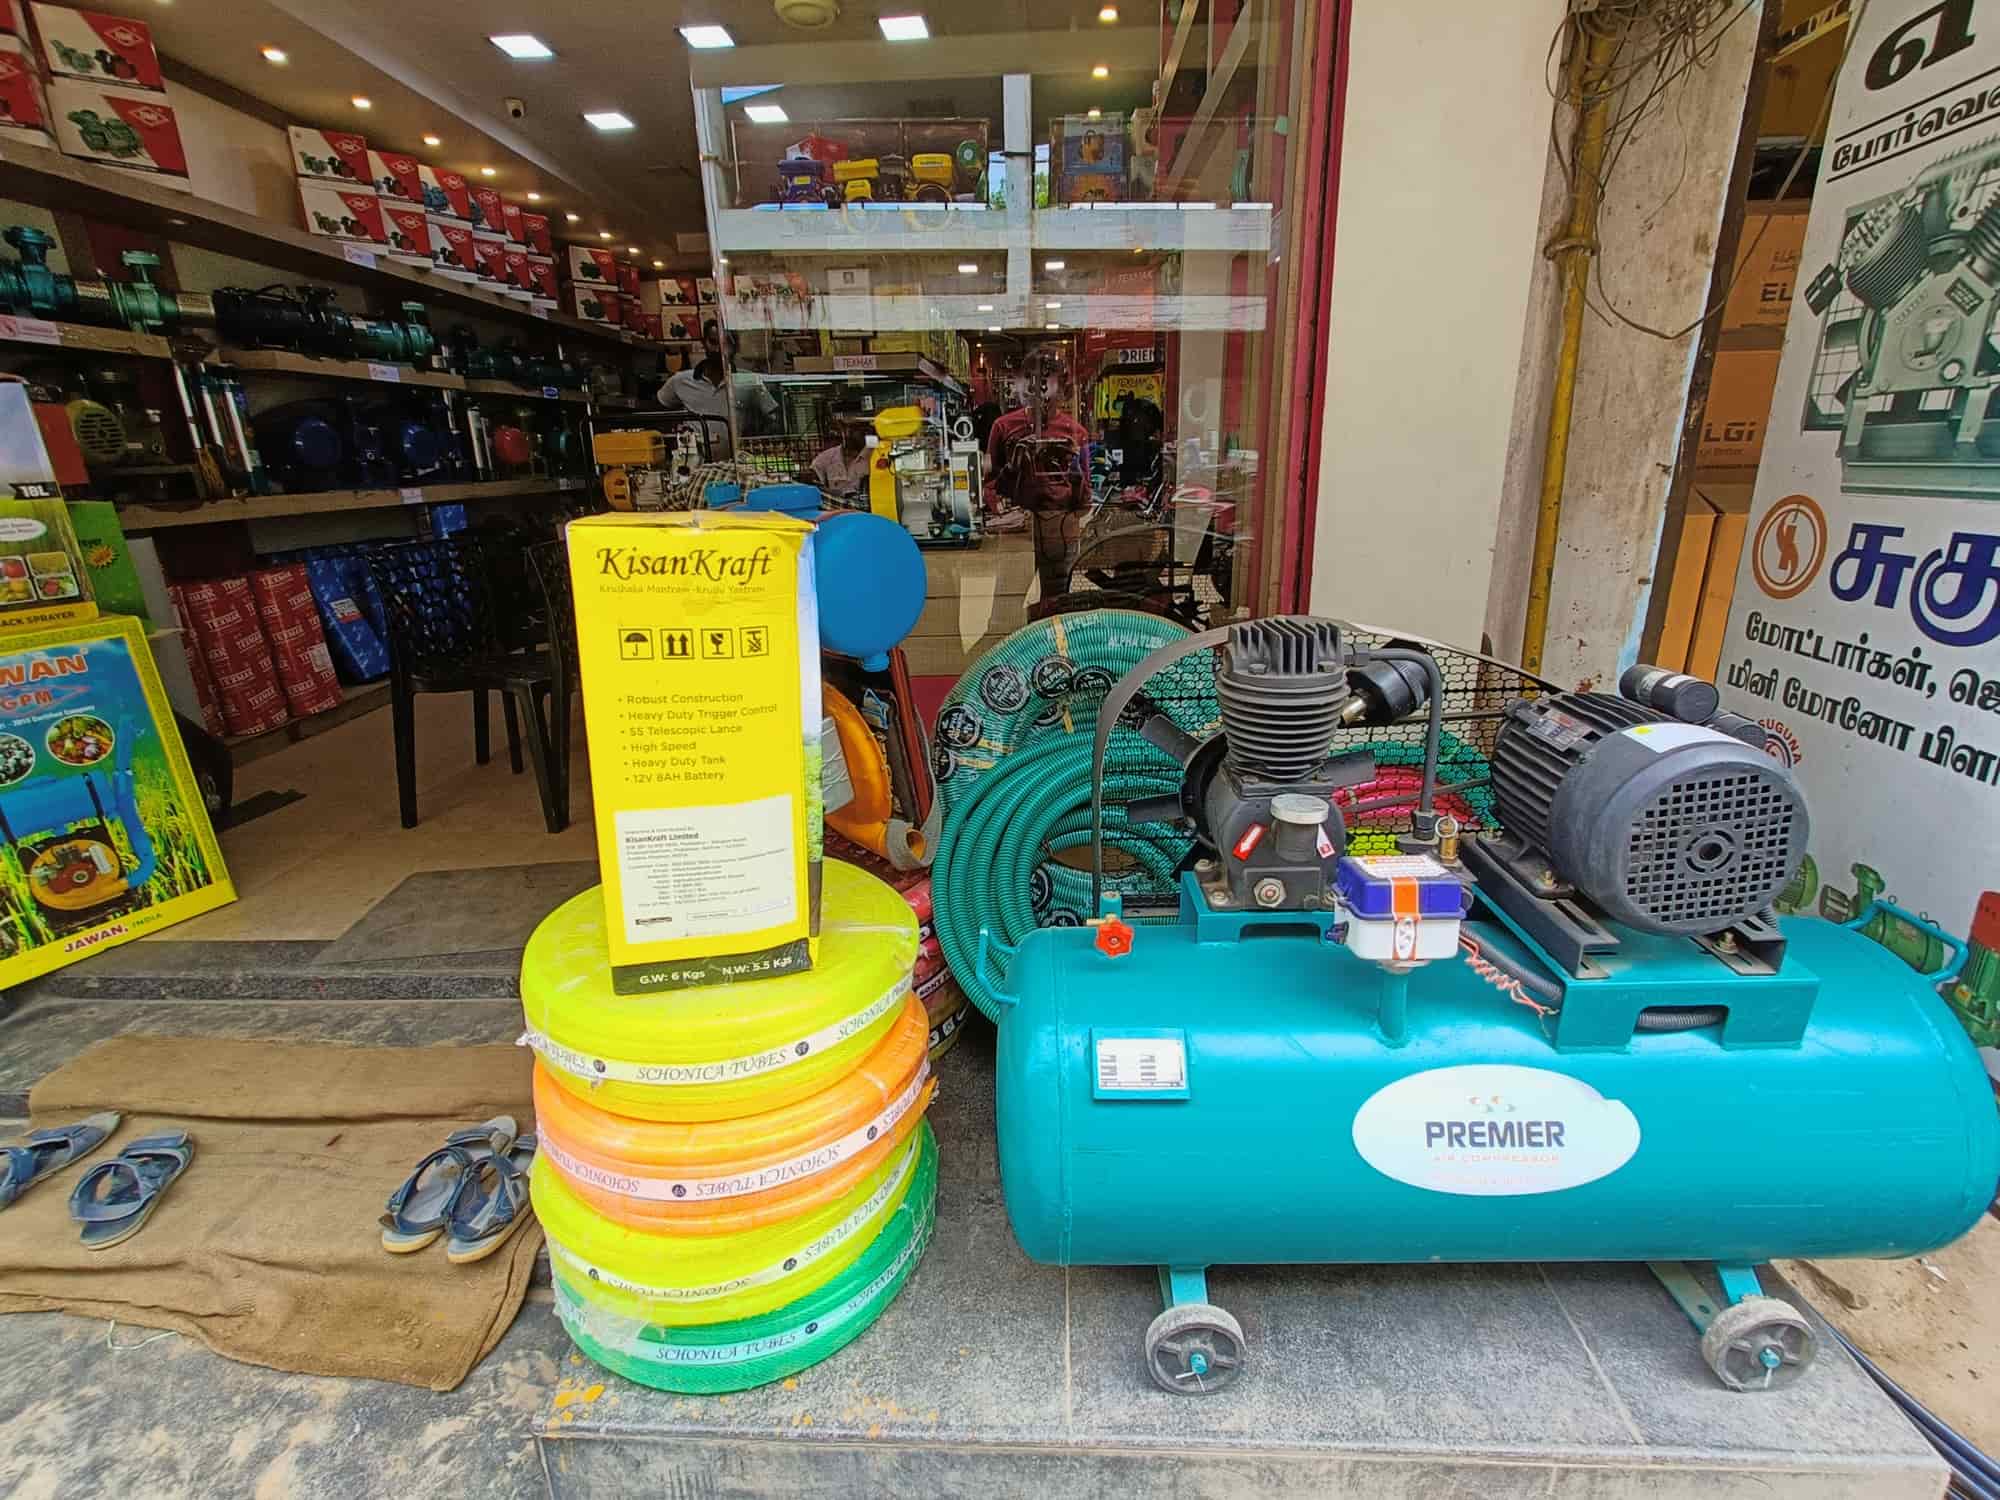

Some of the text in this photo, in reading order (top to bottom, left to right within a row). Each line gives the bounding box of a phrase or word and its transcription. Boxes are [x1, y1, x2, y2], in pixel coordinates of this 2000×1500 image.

[596, 546, 772, 586] KisanKraft
[1727, 658, 1779, 701] மினி
[627, 693, 743, 705] Robust Construction
[628, 704, 777, 721] Heavy Duty Trigger Control
[648, 725, 706, 737] Telescopic
[710, 724, 743, 735] Lance
[630, 741, 697, 753] High Speed
[632, 755, 726, 769] Heavy Duty Tank
[632, 774, 652, 784] 12V
[684, 770, 724, 782] Battery
[625, 834, 668, 844] KisanKraft
[669, 832, 700, 842] Limited
[671, 972, 680, 981] 6
[683, 970, 706, 981] Kgs
[636, 1048, 787, 1080] SCHONICA TUBES
[1425, 1121, 1565, 1148] PREMIER
[696, 1145, 841, 1198] SCHONICA TUBES
[656, 1333, 797, 1362] SCHONICA TUBES
